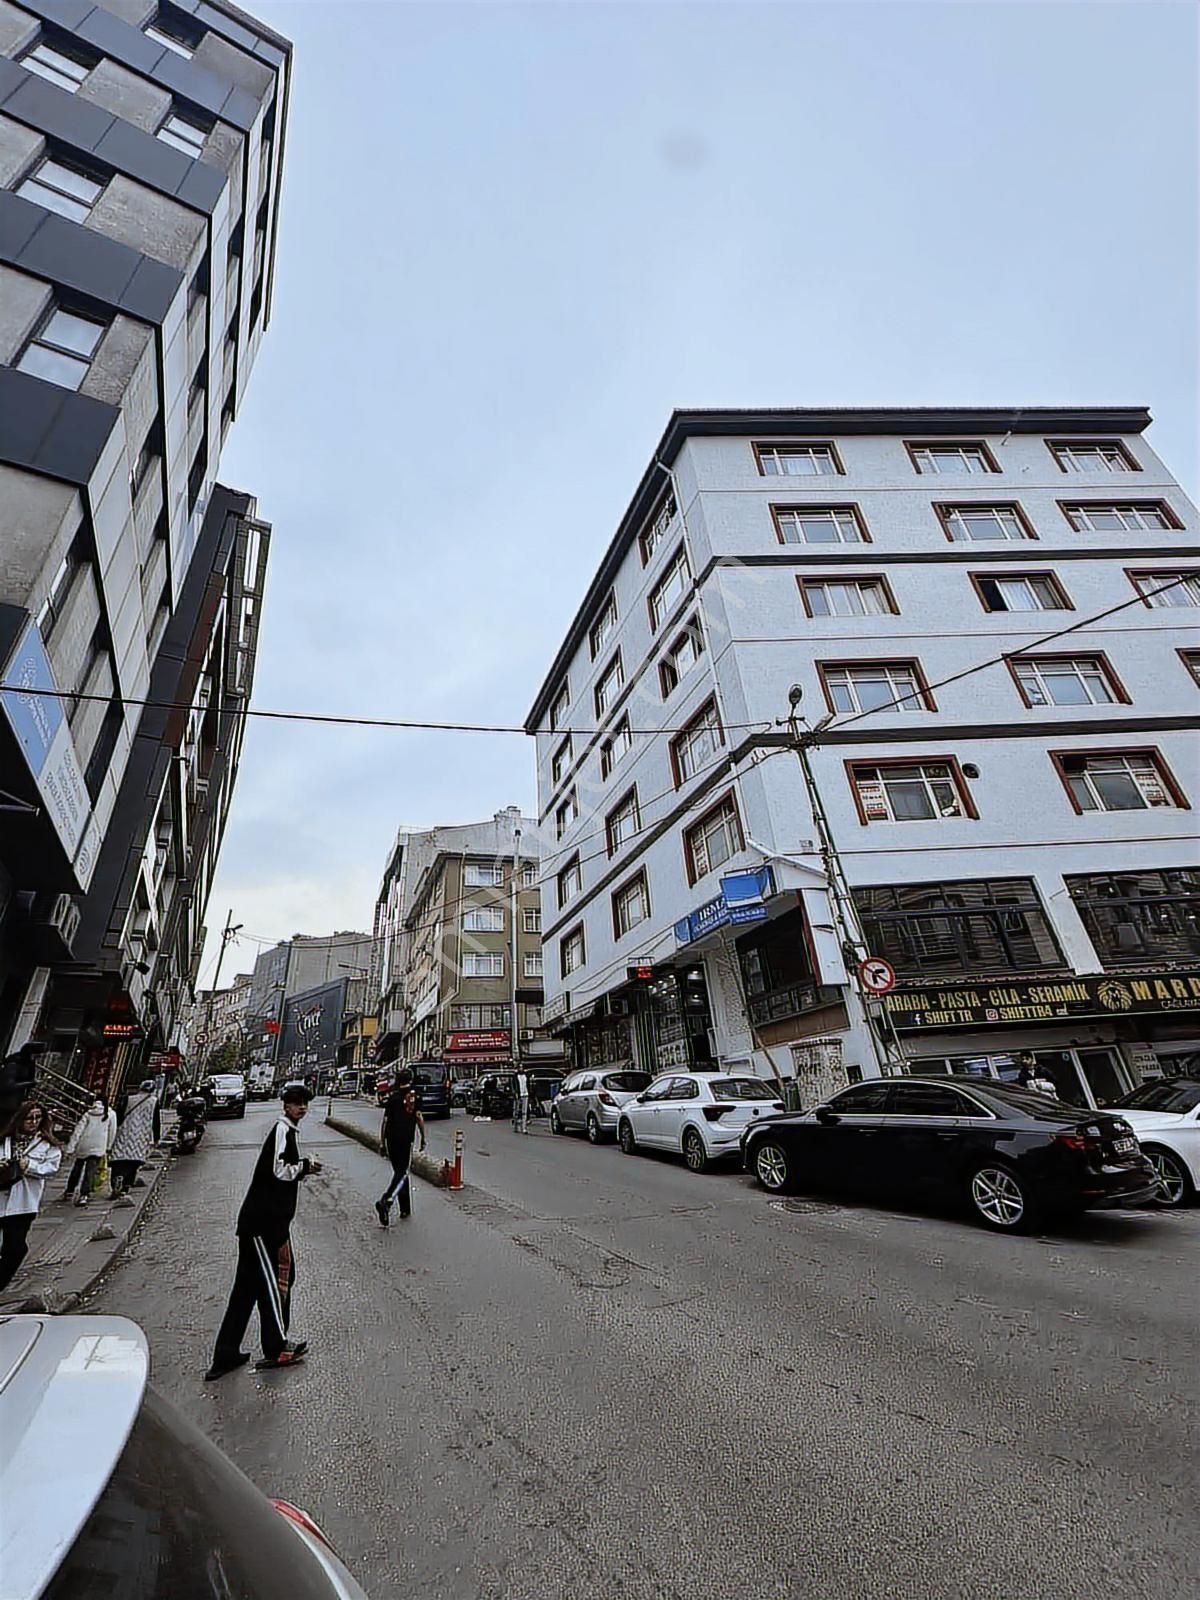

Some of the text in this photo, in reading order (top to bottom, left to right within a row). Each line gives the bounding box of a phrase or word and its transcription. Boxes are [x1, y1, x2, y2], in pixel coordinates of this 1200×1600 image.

[886, 994, 930, 1011] ARABA
[938, 991, 981, 1009] PASTA
[1028, 982, 1091, 1004] SERAMİK
[925, 1010, 956, 1024] SHIFT
